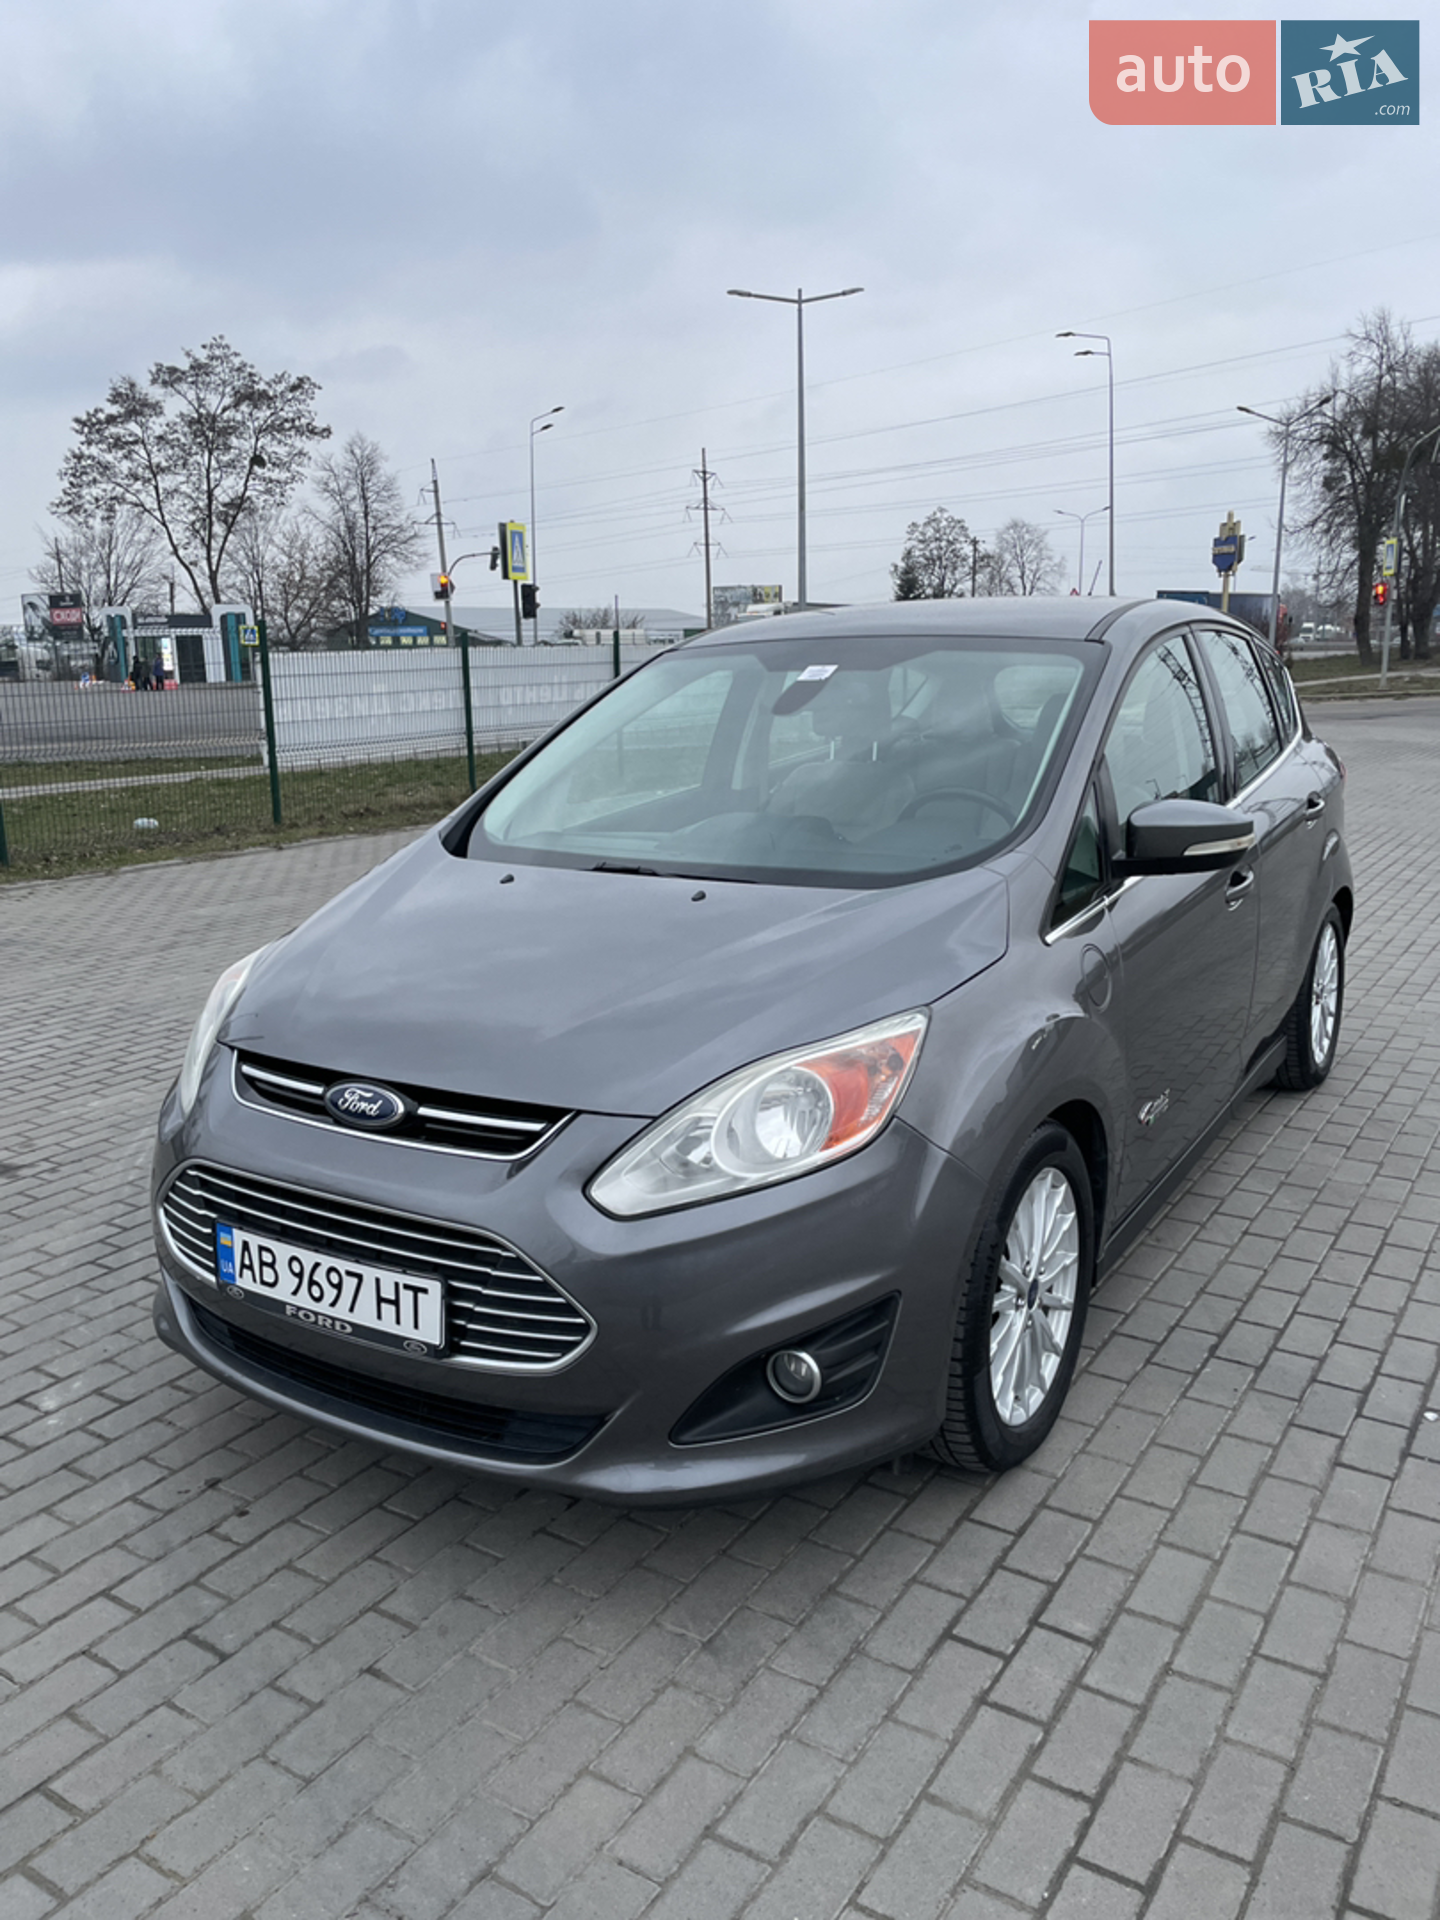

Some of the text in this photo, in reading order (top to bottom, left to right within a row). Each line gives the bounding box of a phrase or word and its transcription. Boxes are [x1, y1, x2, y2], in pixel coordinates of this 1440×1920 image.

[338, 1088, 383, 1117] Ford
[239, 1239, 430, 1331] AB 9697 HT
[285, 1304, 353, 1334] FORD
